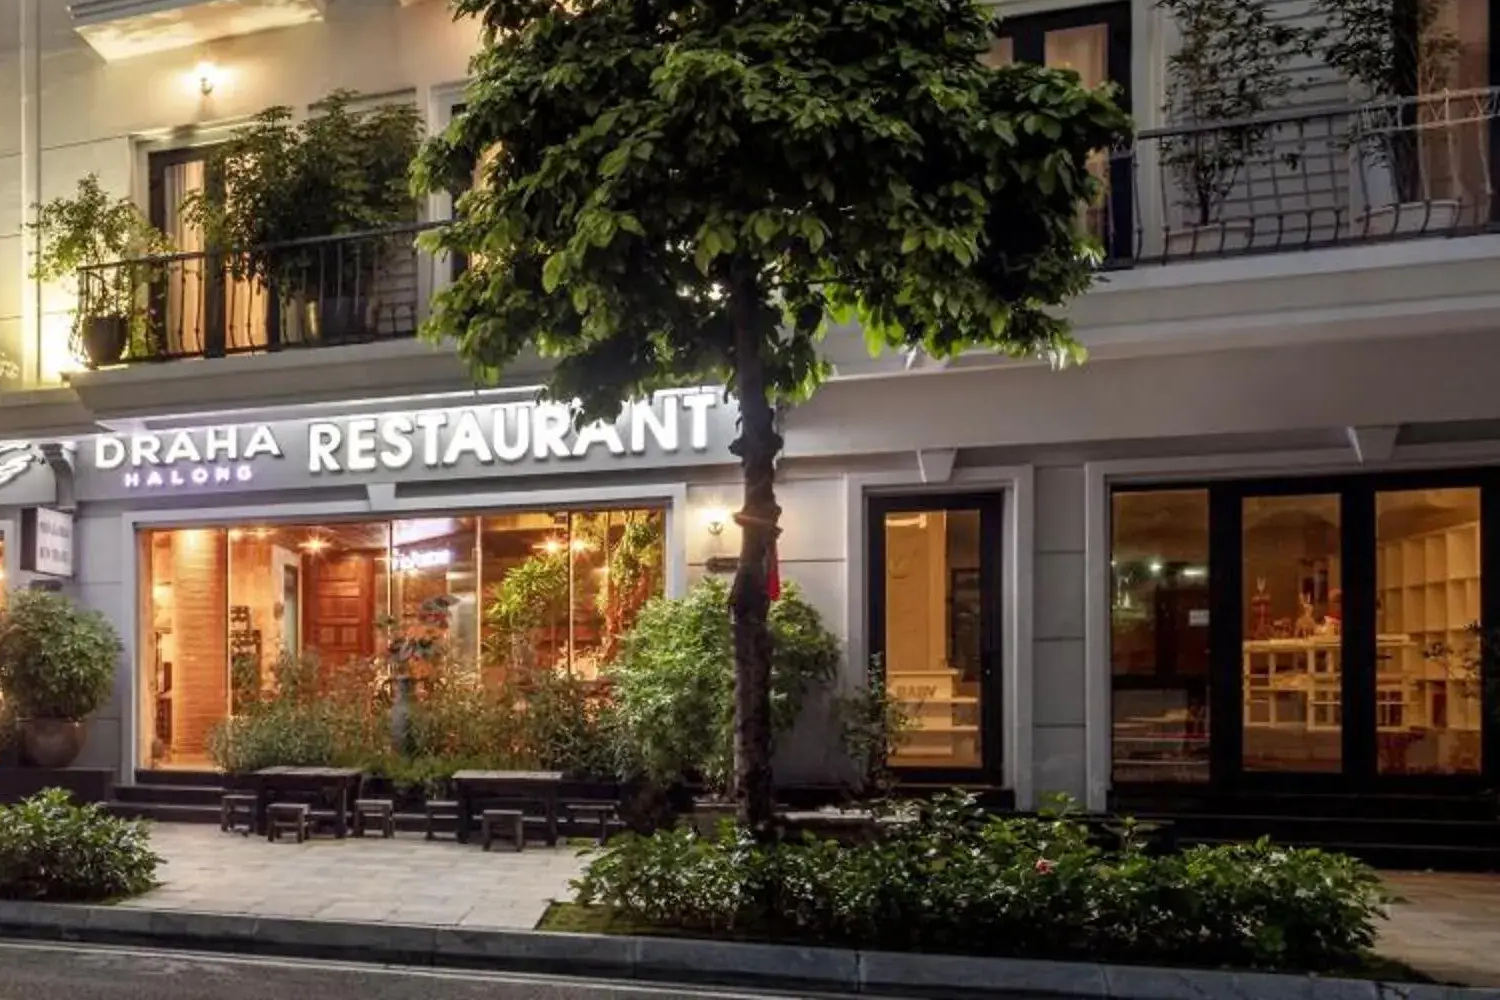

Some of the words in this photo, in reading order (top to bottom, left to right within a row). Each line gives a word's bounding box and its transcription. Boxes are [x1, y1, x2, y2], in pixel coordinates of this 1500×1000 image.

[95, 425, 282, 469] DRAHA
[309, 394, 715, 473] RESTAURANT
[124, 465, 254, 488] HALONG
